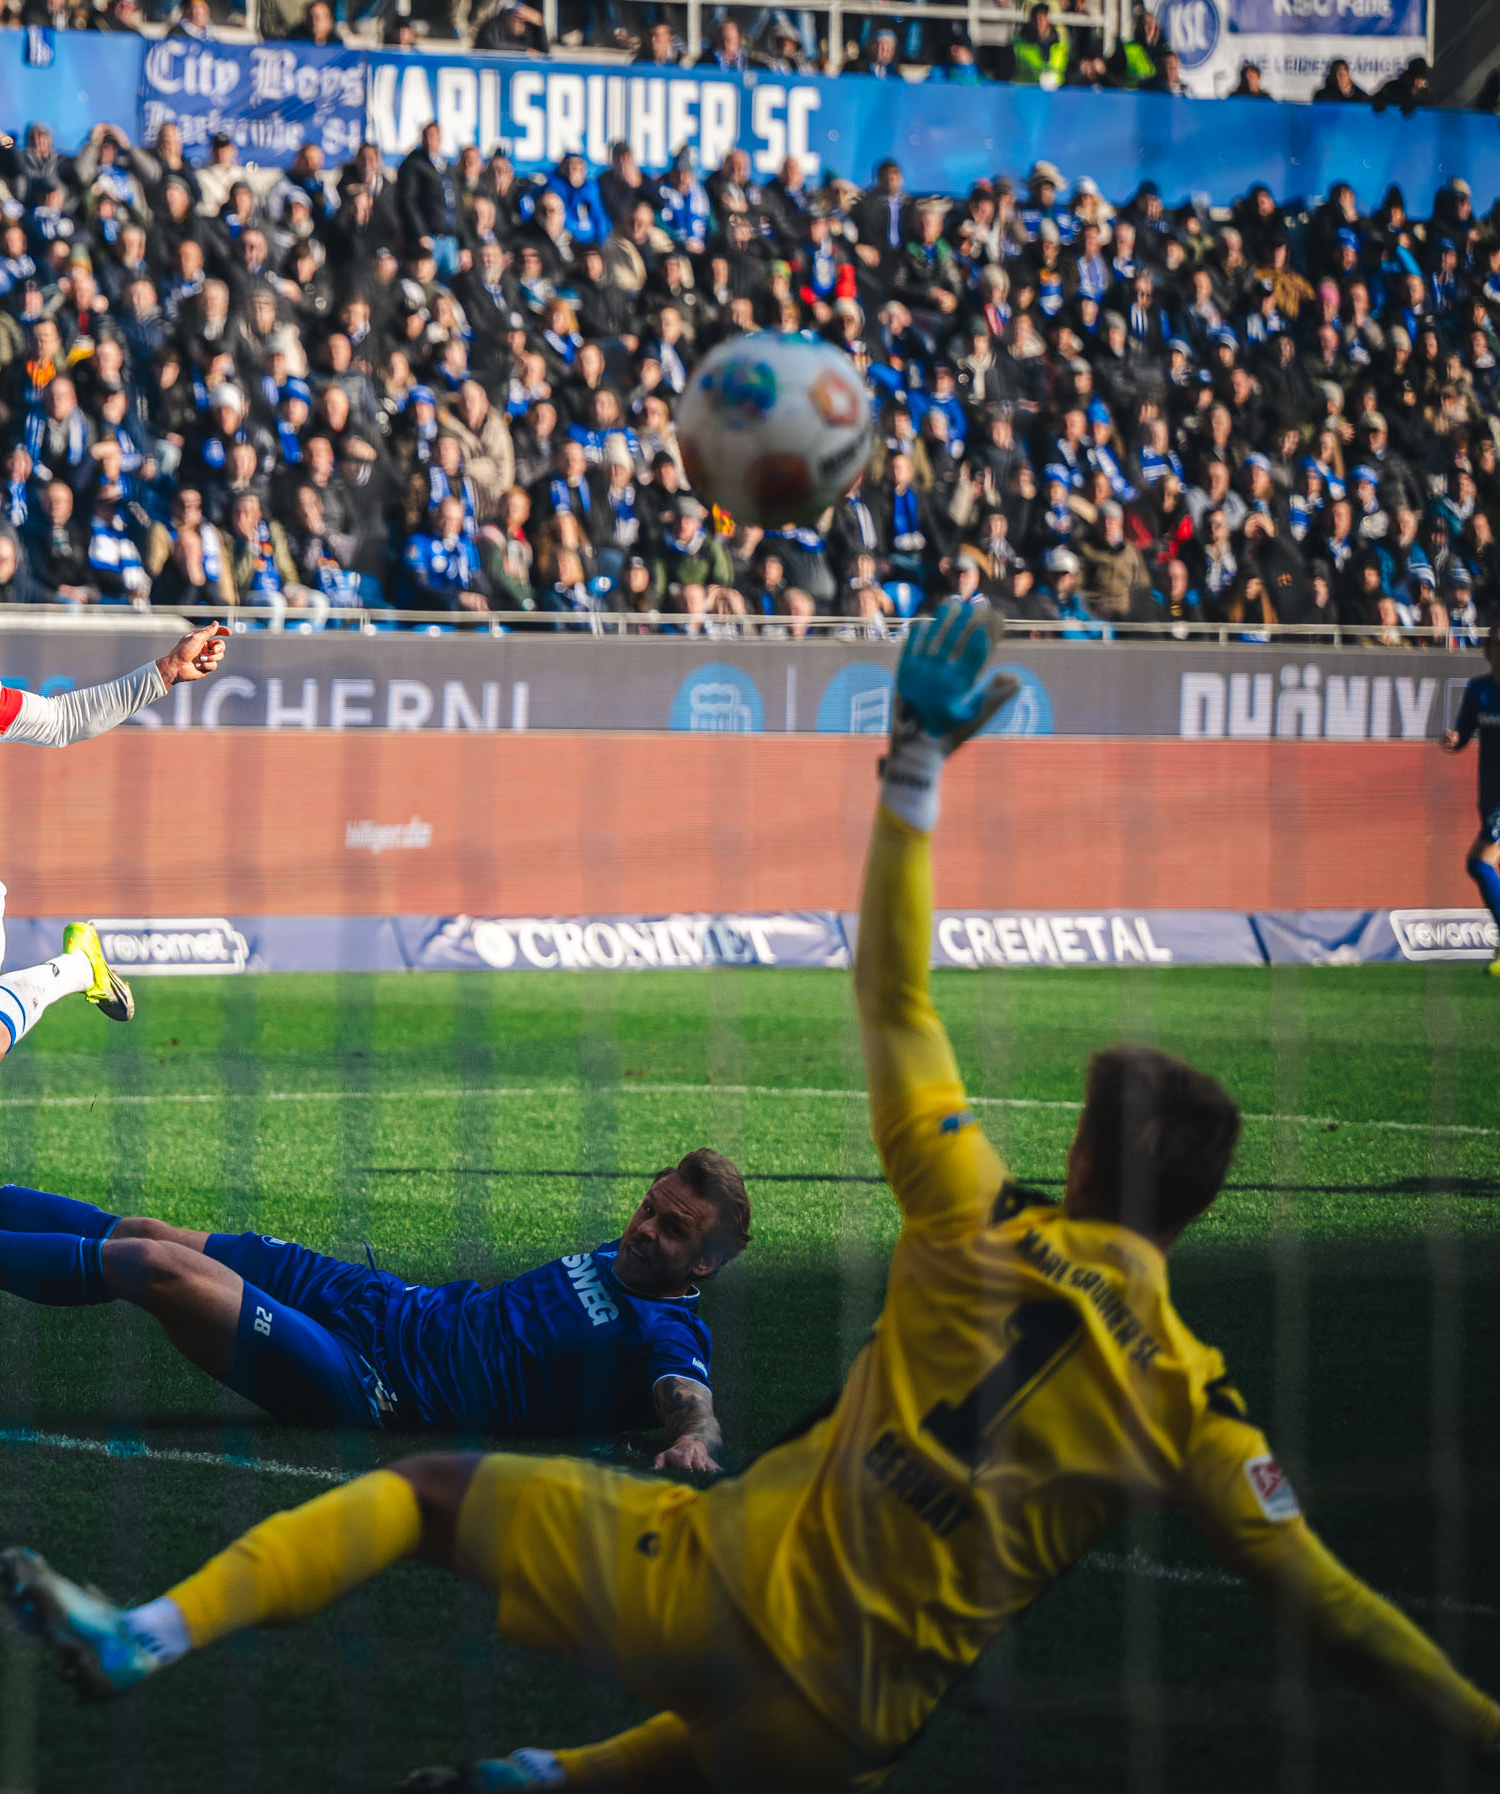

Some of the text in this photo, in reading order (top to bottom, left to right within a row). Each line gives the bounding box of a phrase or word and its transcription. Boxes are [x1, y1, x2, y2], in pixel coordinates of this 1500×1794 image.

[146, 40, 366, 108] City Boys
[367, 63, 820, 175] KARLSRUHER SC
[102, 928, 230, 962] revomet
[518, 921, 779, 969] CRONIMET
[938, 916, 1173, 964] CREMETAL
[1404, 922, 1499, 948] revome
[561, 1253, 620, 1327] SWEG
[253, 1305, 273, 1337] 28
